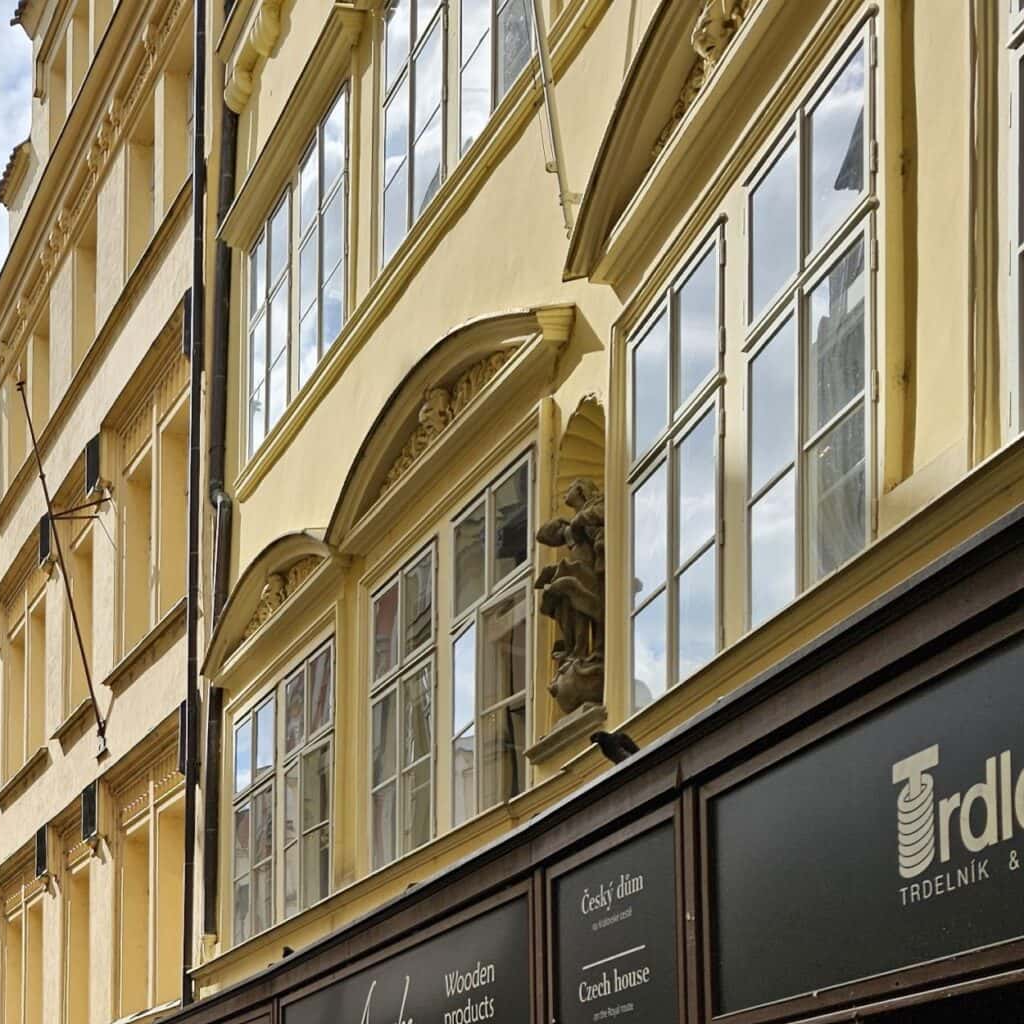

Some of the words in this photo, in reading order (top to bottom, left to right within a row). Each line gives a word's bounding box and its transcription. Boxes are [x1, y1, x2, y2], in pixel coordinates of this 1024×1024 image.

[893, 743, 1024, 879] Trdl
[581, 881, 614, 915] Český
[617, 873, 644, 899] dům
[899, 858, 990, 905] TRDELNÍK
[1008, 849, 1020, 871] &
[444, 961, 495, 998] Wooden
[579, 971, 611, 1003] Czech
[615, 966, 650, 993] house
